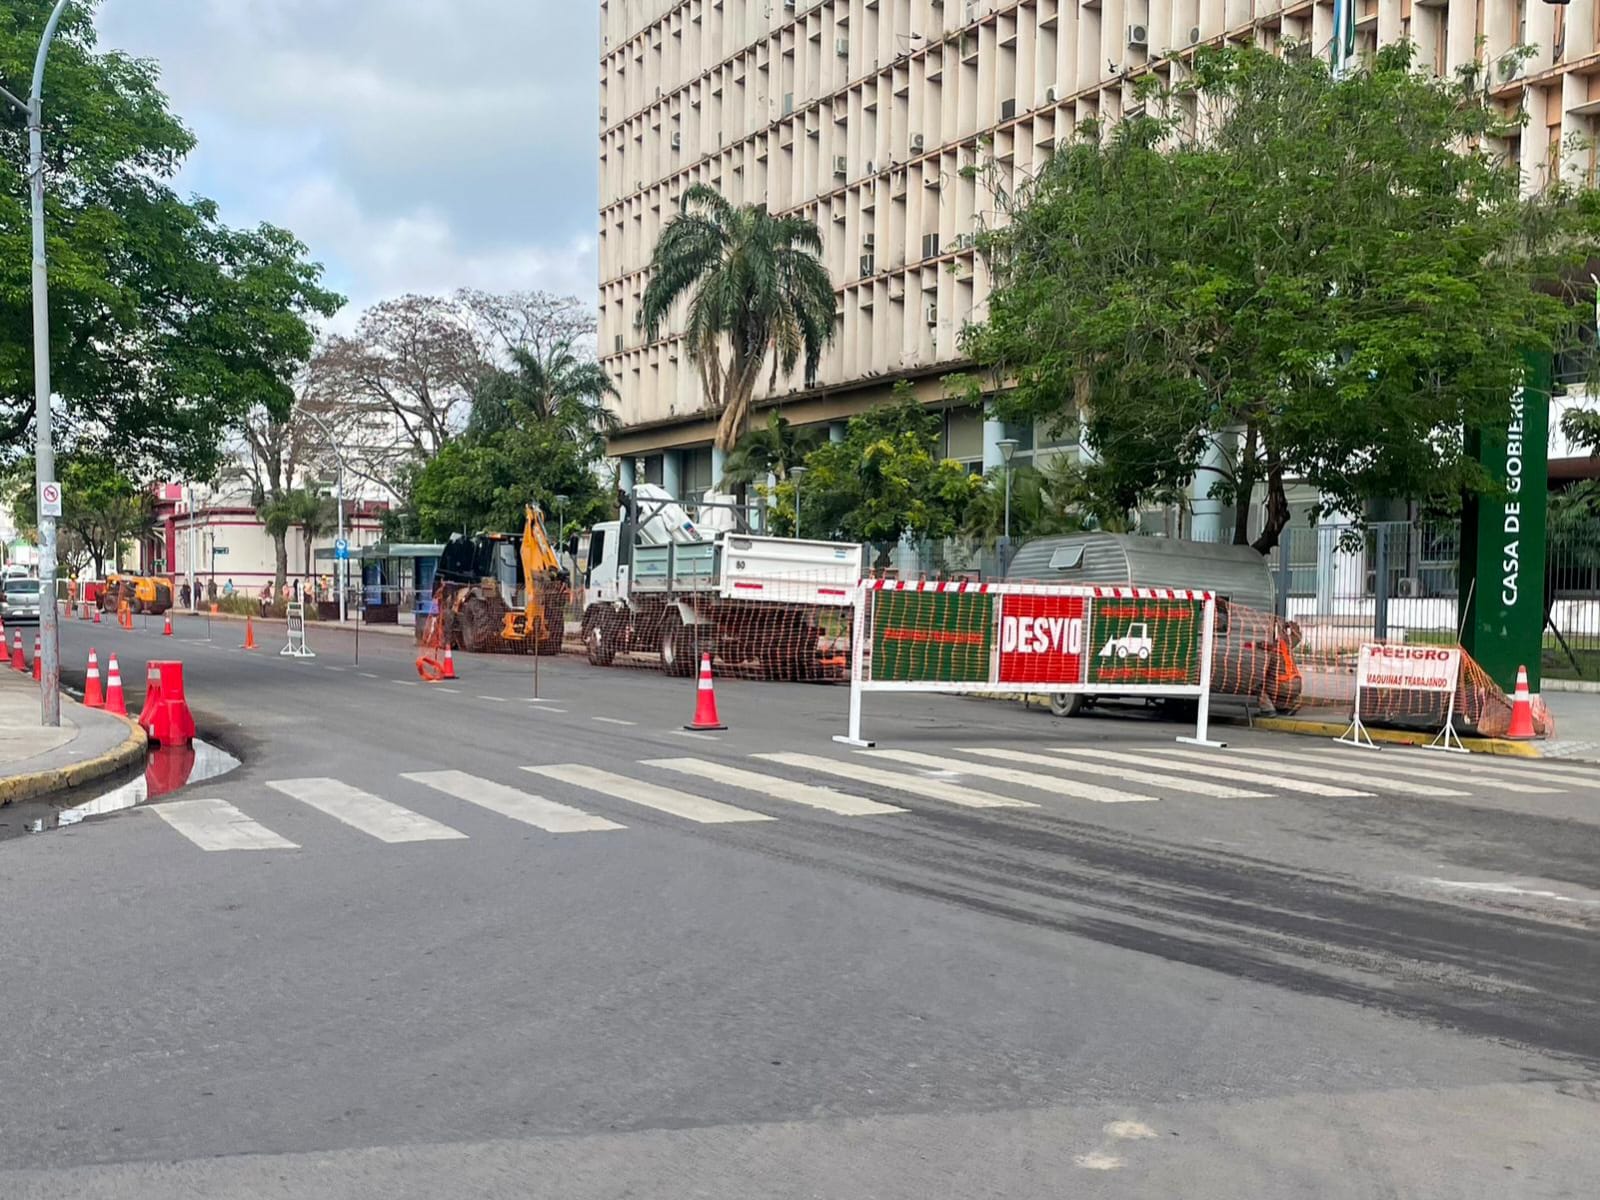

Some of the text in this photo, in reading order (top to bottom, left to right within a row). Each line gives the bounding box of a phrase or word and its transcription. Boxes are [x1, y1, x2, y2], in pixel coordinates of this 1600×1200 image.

[1502, 367, 1525, 606] CASA DE GOBIERN
[1002, 615, 1082, 655] DESVIO
[1370, 646, 1450, 661] PELIGRO
[1366, 673, 1448, 689] MAQUINAS TRABAJANDO
